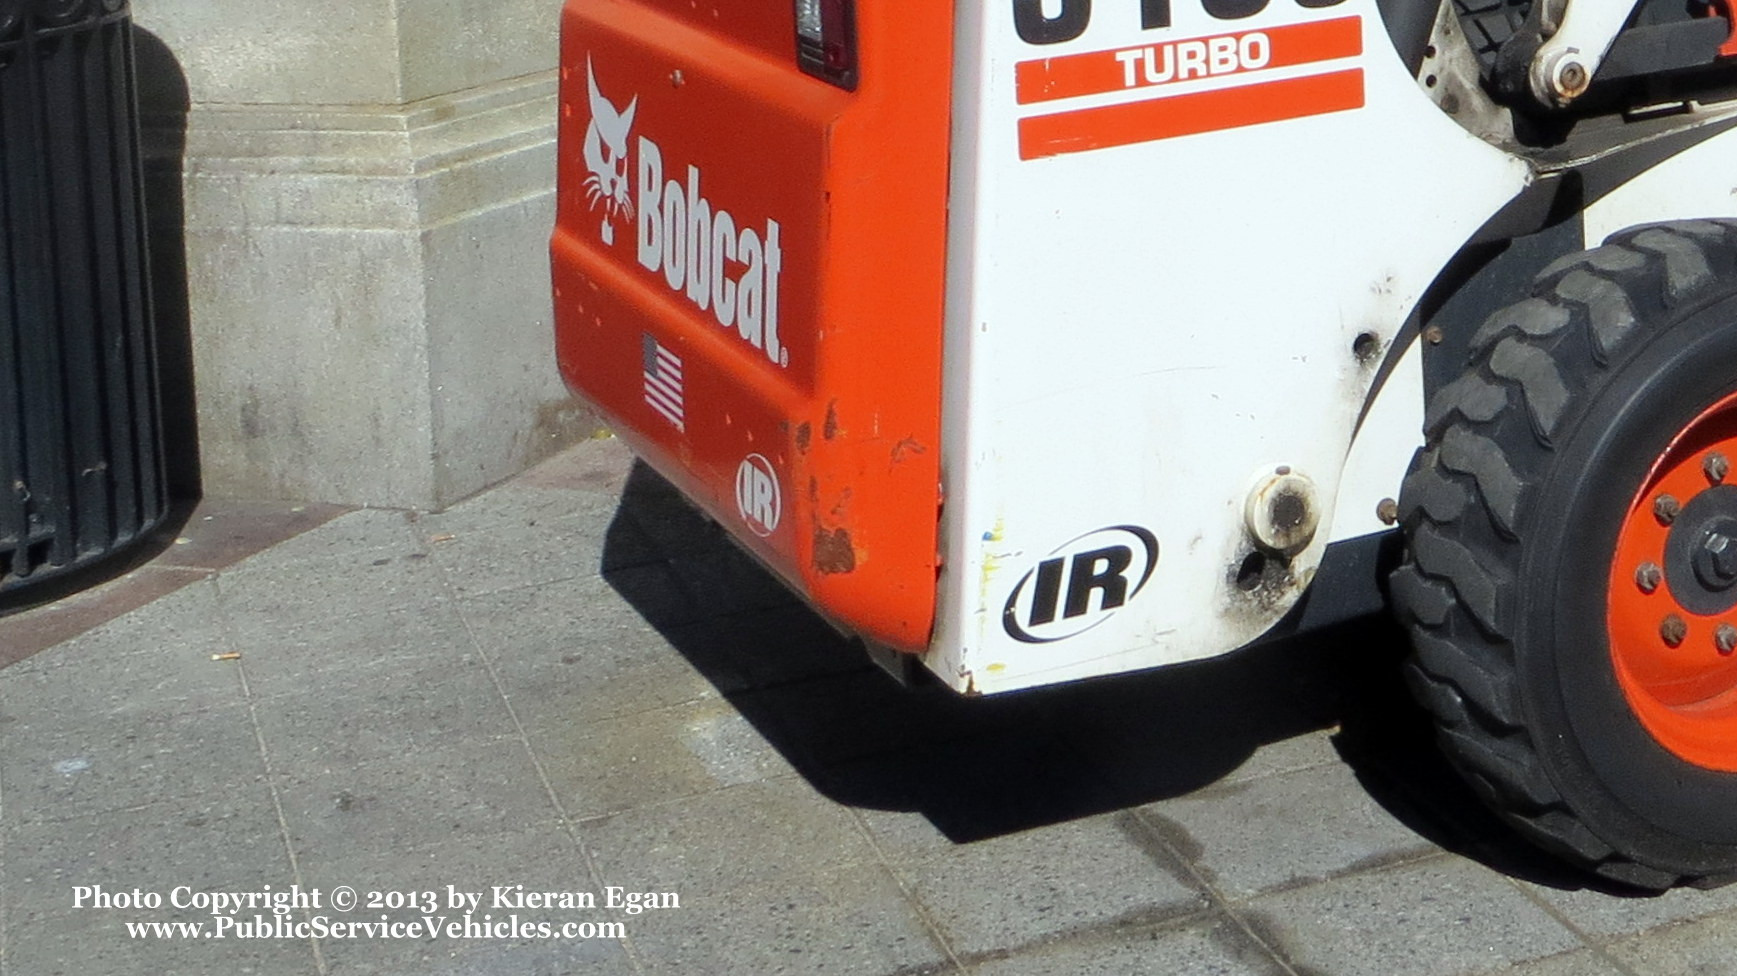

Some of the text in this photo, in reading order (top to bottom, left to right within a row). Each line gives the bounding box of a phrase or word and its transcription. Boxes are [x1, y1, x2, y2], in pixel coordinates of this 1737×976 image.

[1115, 32, 1272, 88] TURBO
[638, 135, 782, 364] Bobcat
[742, 460, 776, 532] IR
[1028, 545, 1132, 628] IR
